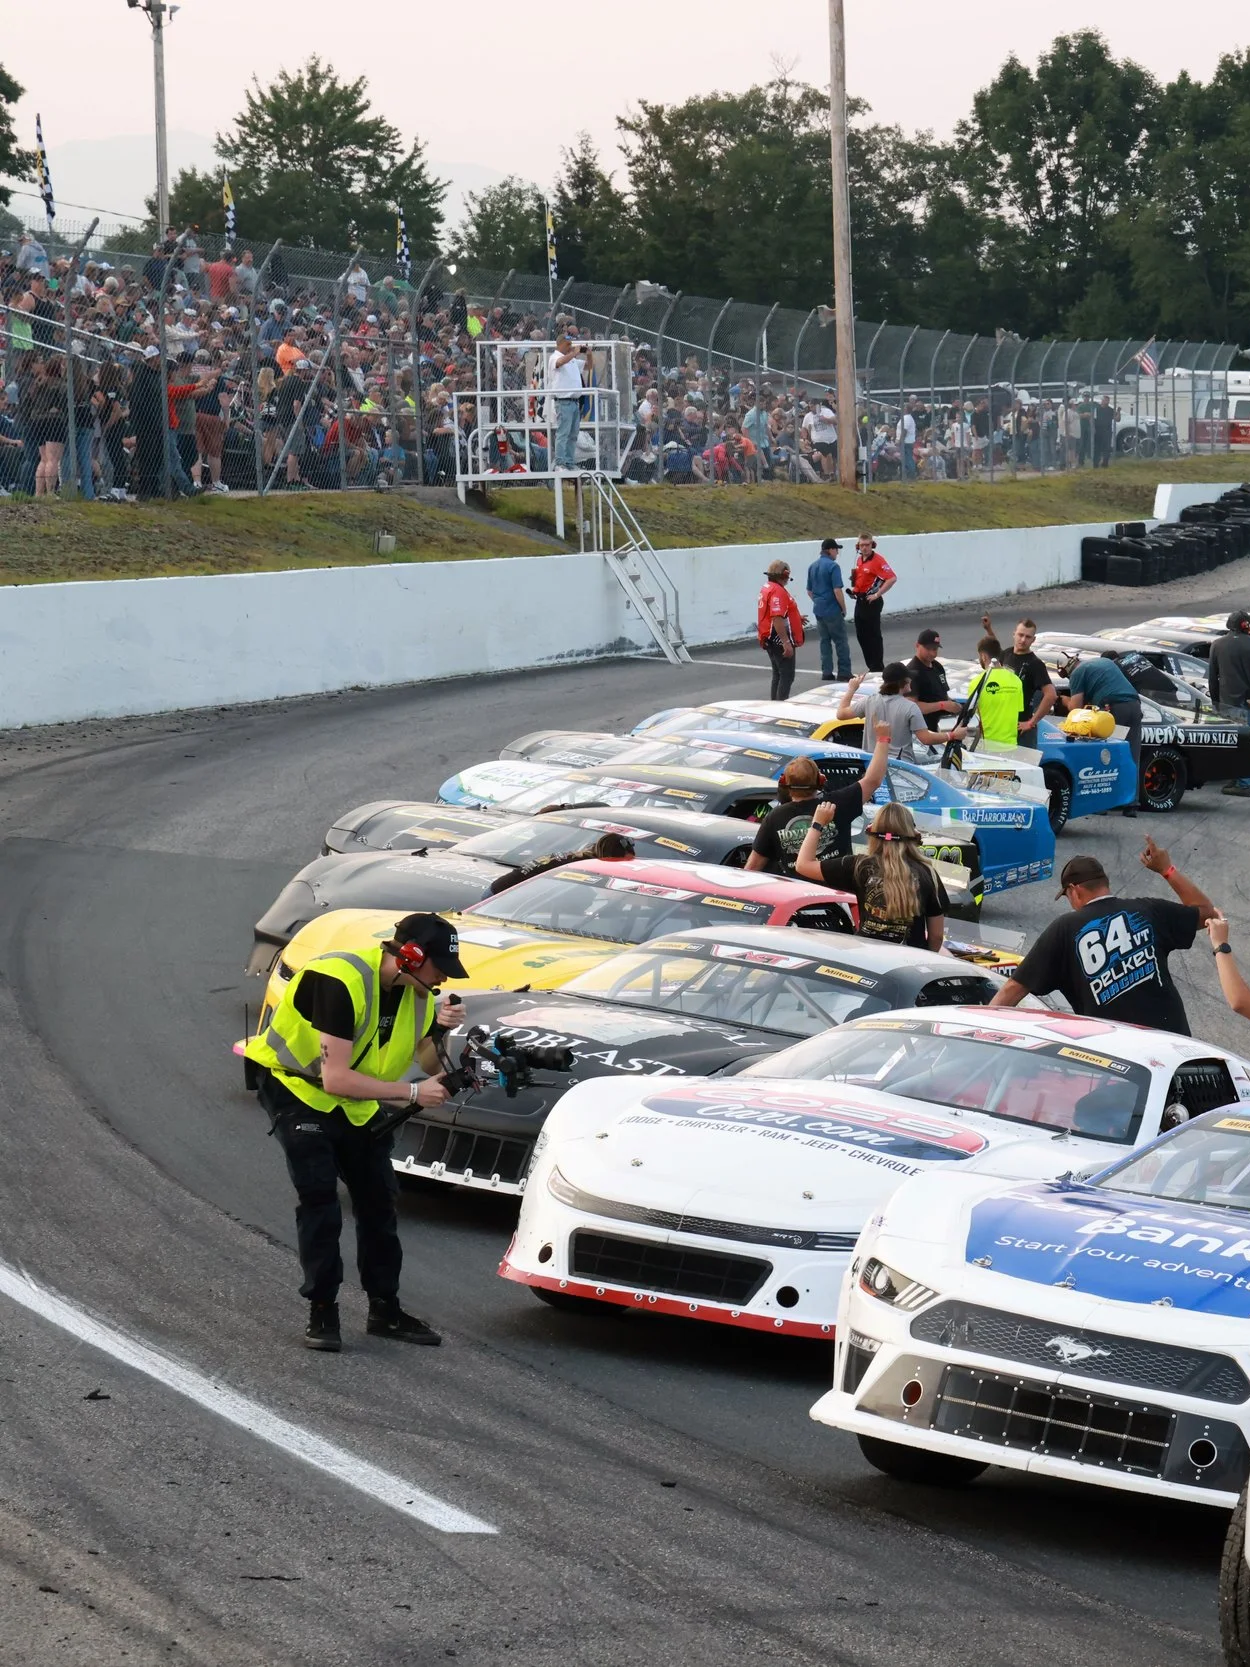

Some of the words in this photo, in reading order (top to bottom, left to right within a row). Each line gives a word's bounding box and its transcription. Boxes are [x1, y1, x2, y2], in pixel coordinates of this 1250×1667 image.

[1187, 732, 1210, 744] AUTO
[1211, 733, 1239, 745] SALES
[709, 896, 738, 908] Milton
[1077, 913, 1134, 976] 64
[1133, 927, 1150, 947] VT
[727, 950, 791, 966] ACT
[823, 967, 855, 981] Milton
[1098, 961, 1156, 1003] RACING
[951, 1028, 1026, 1044] ACT
[1067, 1050, 1104, 1065] Milton
[1109, 1062, 1128, 1072] CAT
[694, 1088, 966, 1139] GOSS
[696, 1103, 897, 1147] Cars.com
[675, 1119, 748, 1135] CHRYSLER
[757, 1129, 792, 1142] RAM
[800, 1137, 839, 1152] JEEP
[847, 1149, 926, 1178] CHEVROLE
[994, 1235, 1069, 1254] Start
[1066, 1245, 1140, 1265] your
